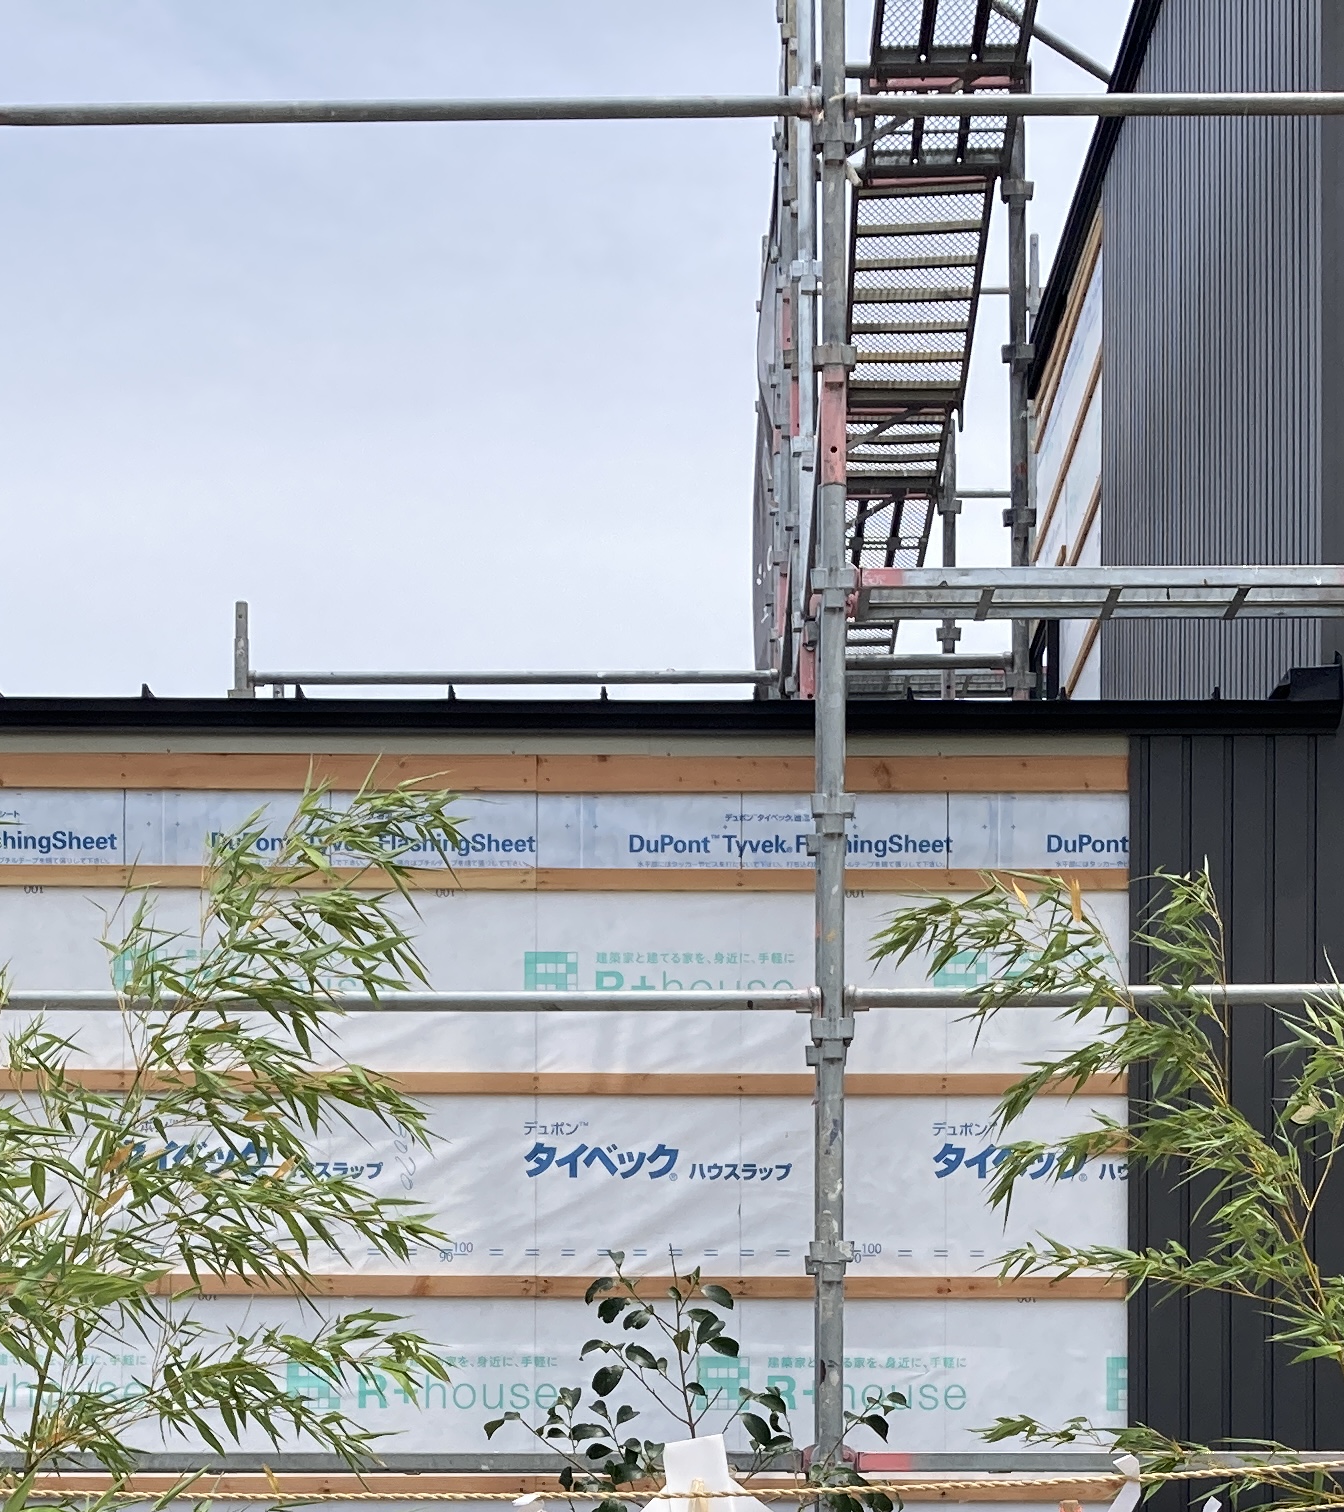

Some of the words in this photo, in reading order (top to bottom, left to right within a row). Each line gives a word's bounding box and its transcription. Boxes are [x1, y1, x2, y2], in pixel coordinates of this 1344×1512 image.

[689, 1163, 793, 1181] ハウスラップ
